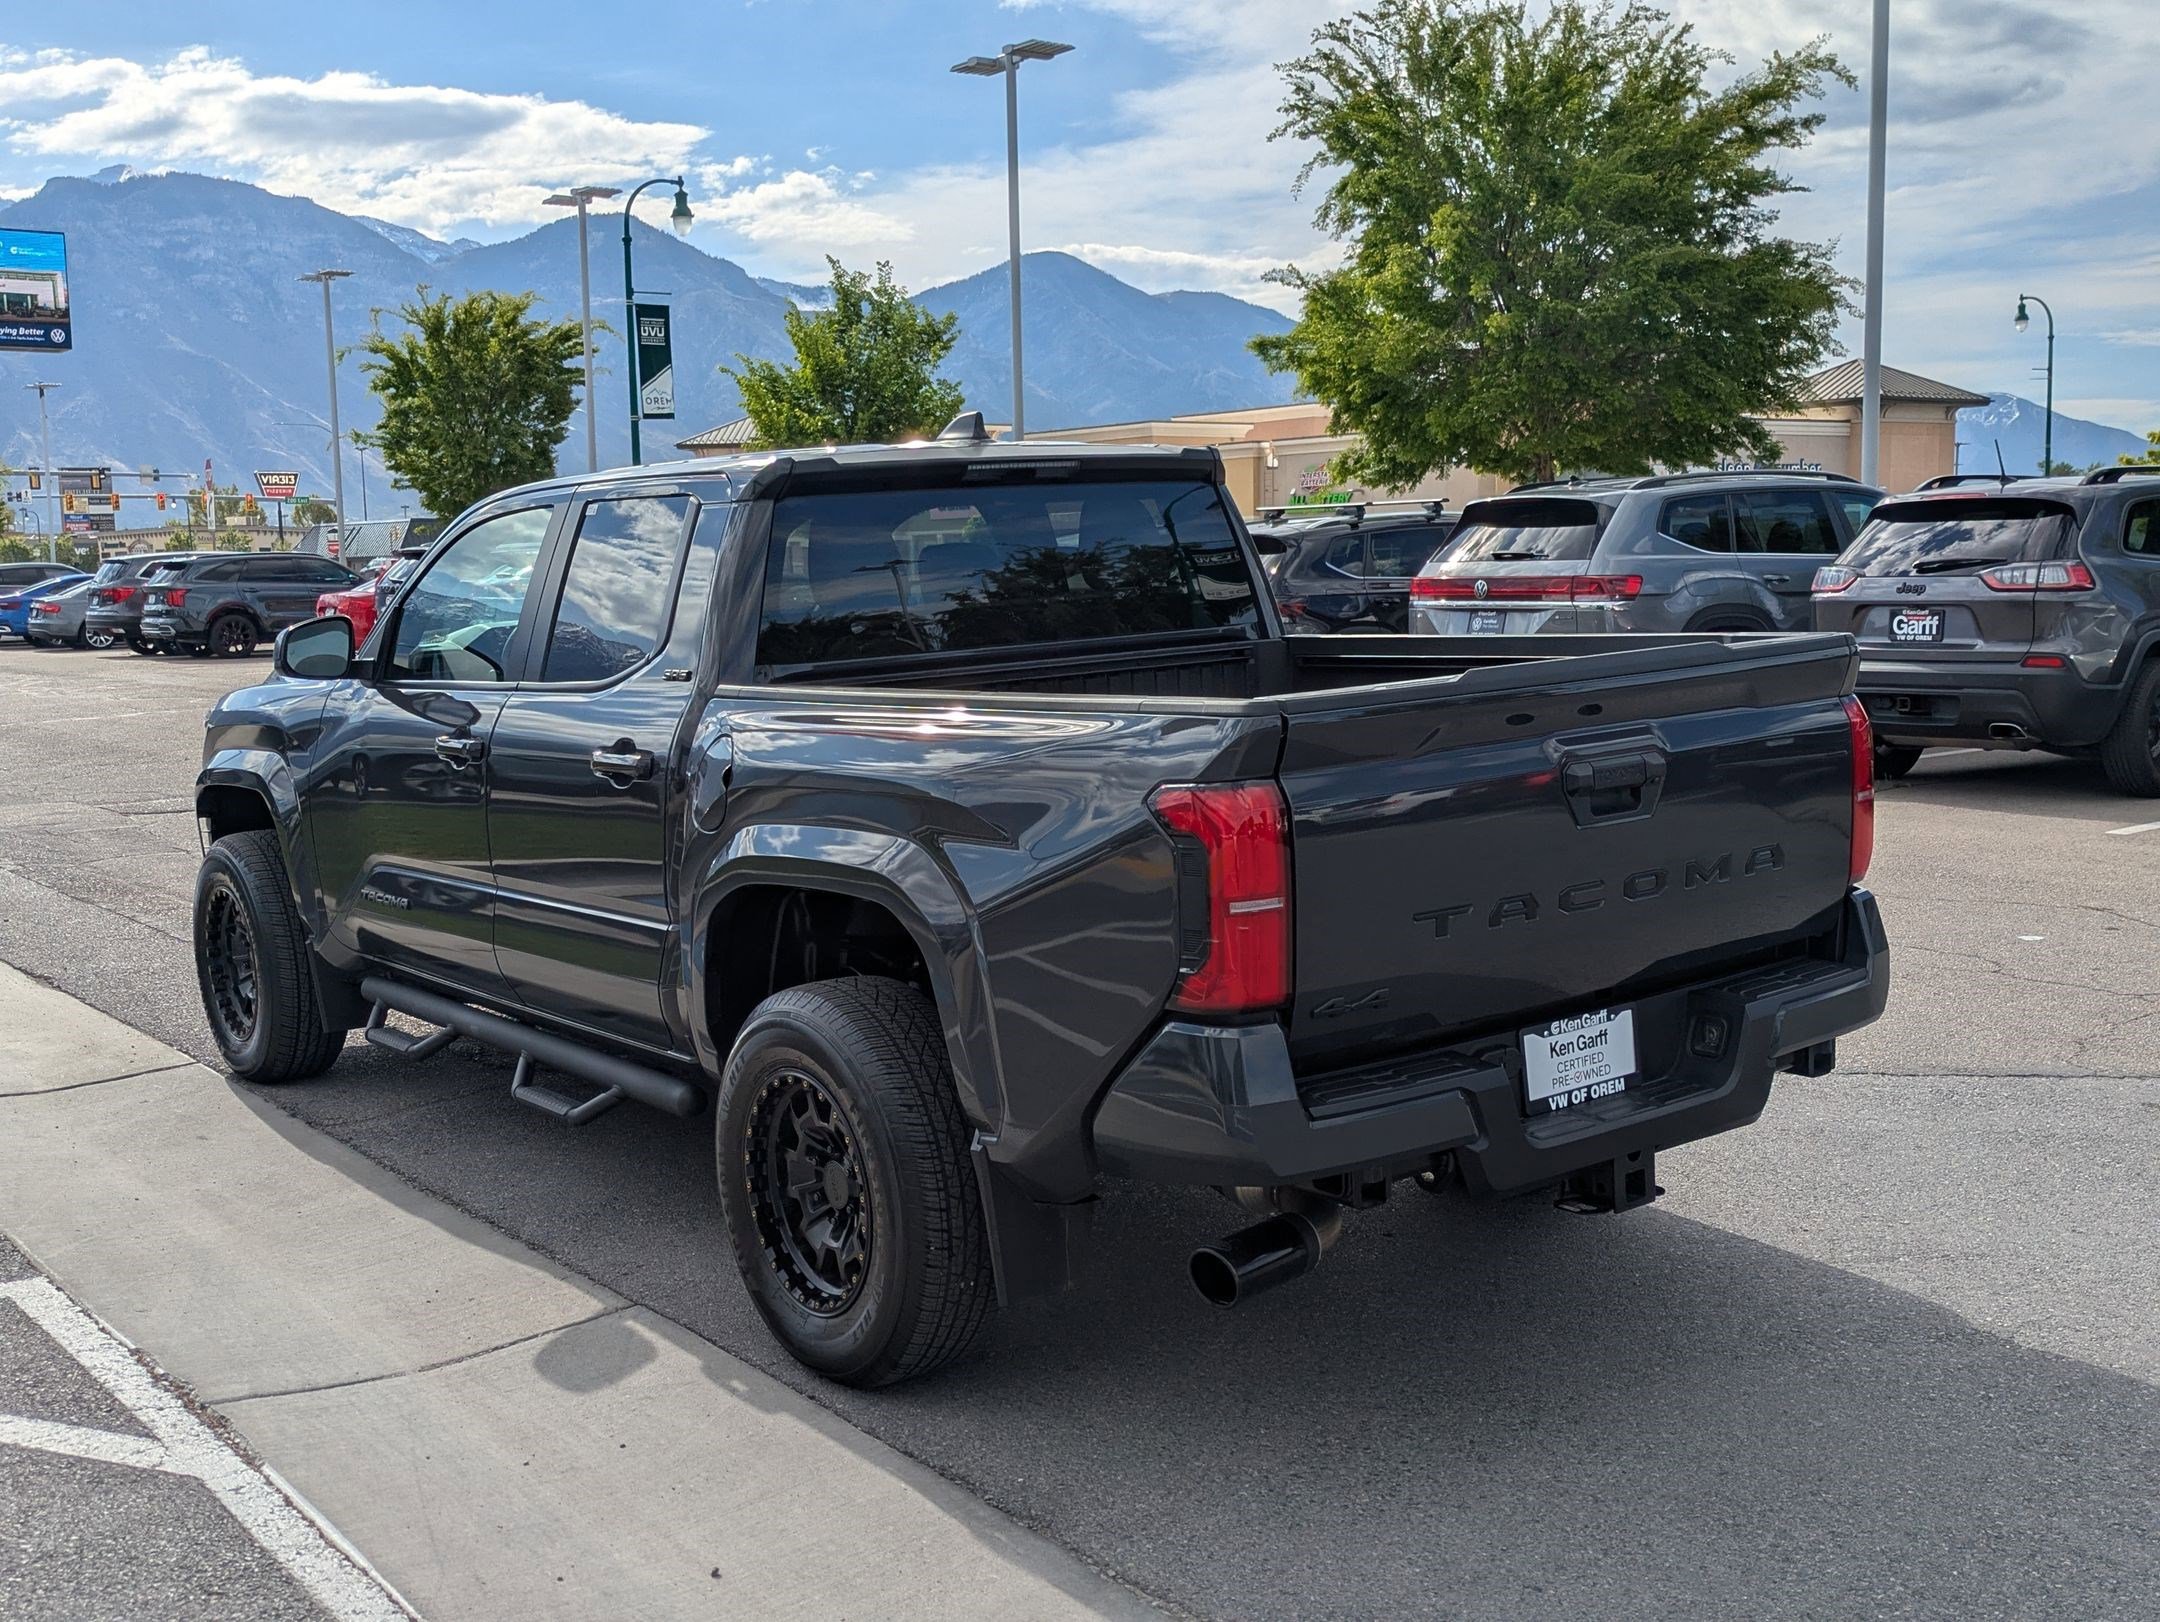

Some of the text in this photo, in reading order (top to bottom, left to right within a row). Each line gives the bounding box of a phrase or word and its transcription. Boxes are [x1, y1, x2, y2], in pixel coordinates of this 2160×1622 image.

[19, 327, 45, 336] Better
[641, 326, 665, 337] UVU
[1896, 582, 1927, 596] Jeep
[1893, 615, 1939, 635] Garff
[361, 888, 409, 911] TACOMA
[1413, 842, 1786, 938] TACOMA
[1560, 1009, 1608, 1034] Ken Garff
[1549, 1028, 1609, 1059] Ken Garff
[1556, 1051, 1605, 1074] CERTIFIED
[1548, 1077, 1626, 1111] VW OF OREM
